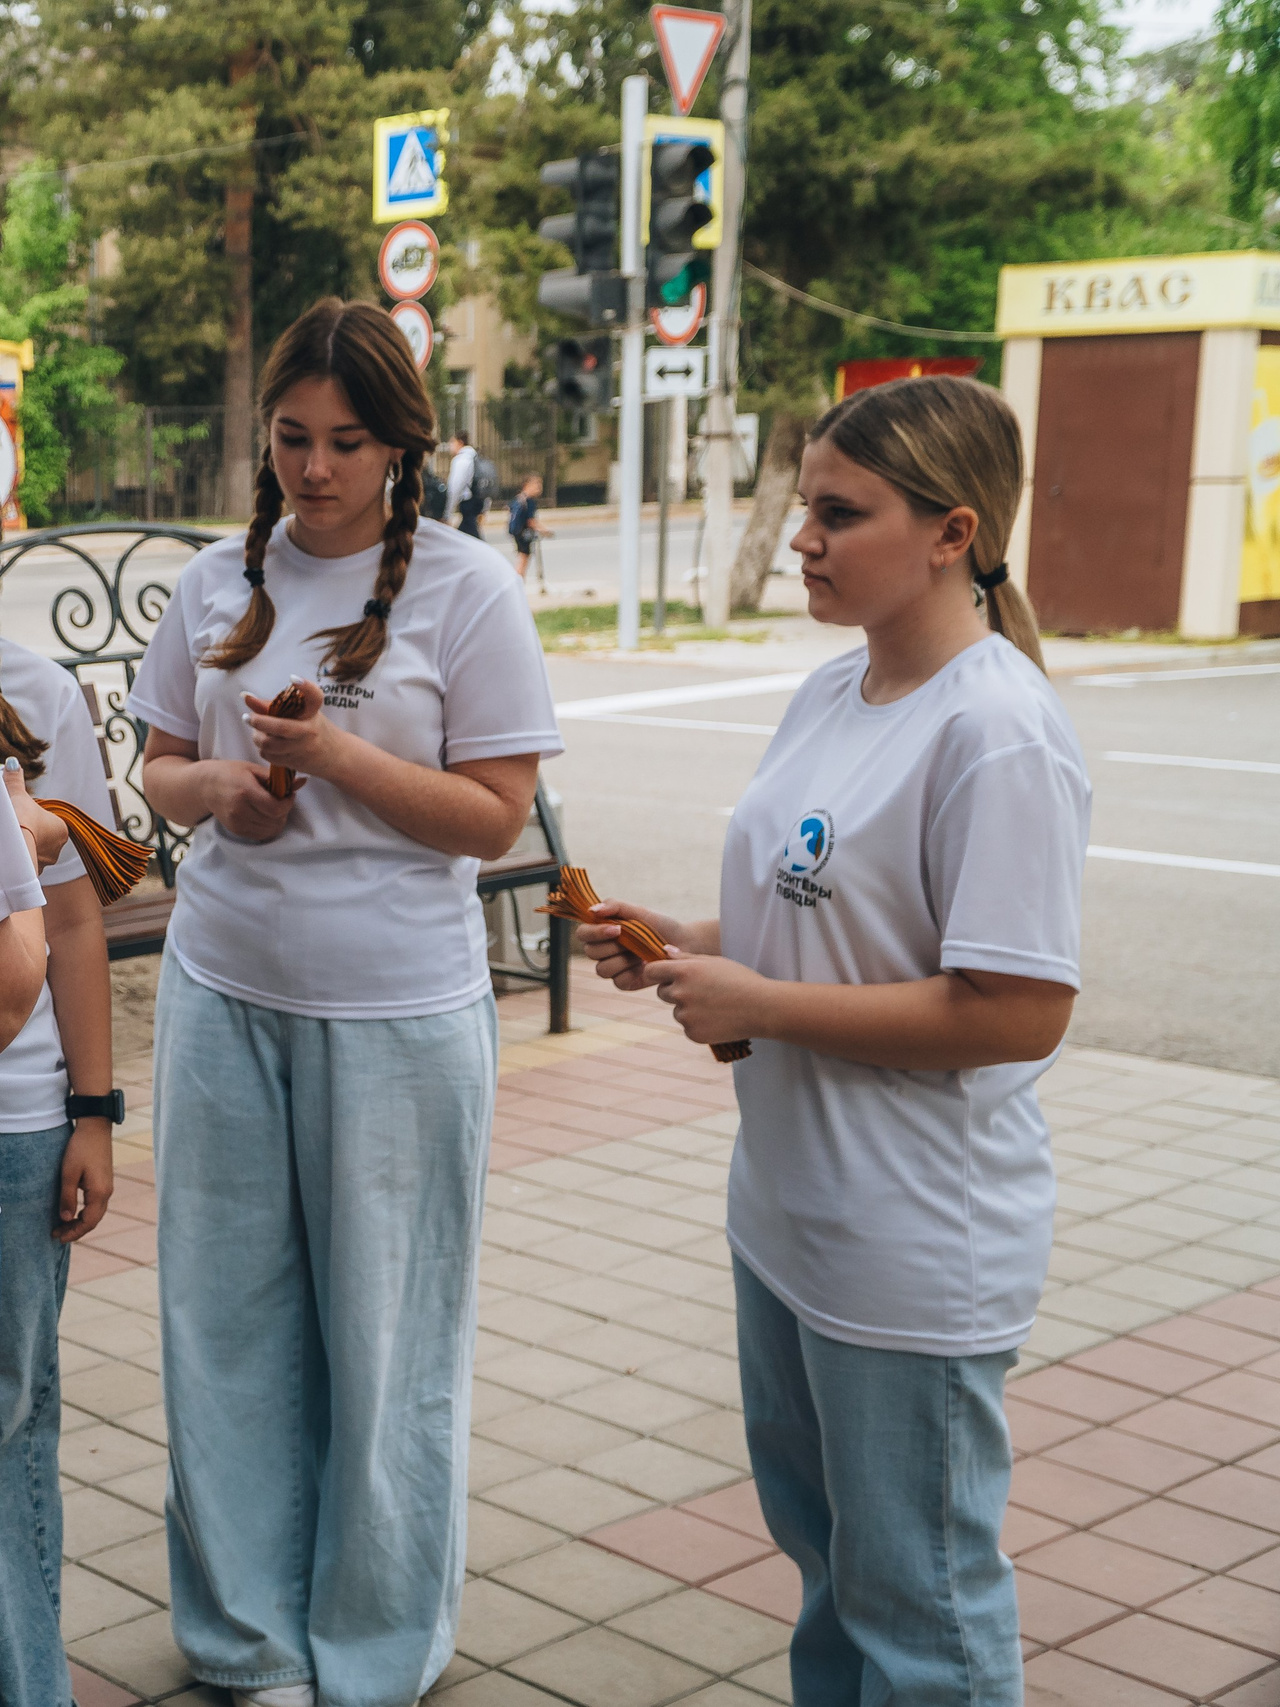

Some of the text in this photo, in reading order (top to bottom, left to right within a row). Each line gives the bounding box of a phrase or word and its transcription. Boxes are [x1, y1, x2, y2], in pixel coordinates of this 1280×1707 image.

[1042, 271, 1194, 316] КВАС
[321, 684, 374, 699] ОНТЕРЫ
[324, 696, 359, 709] БЕДЫ
